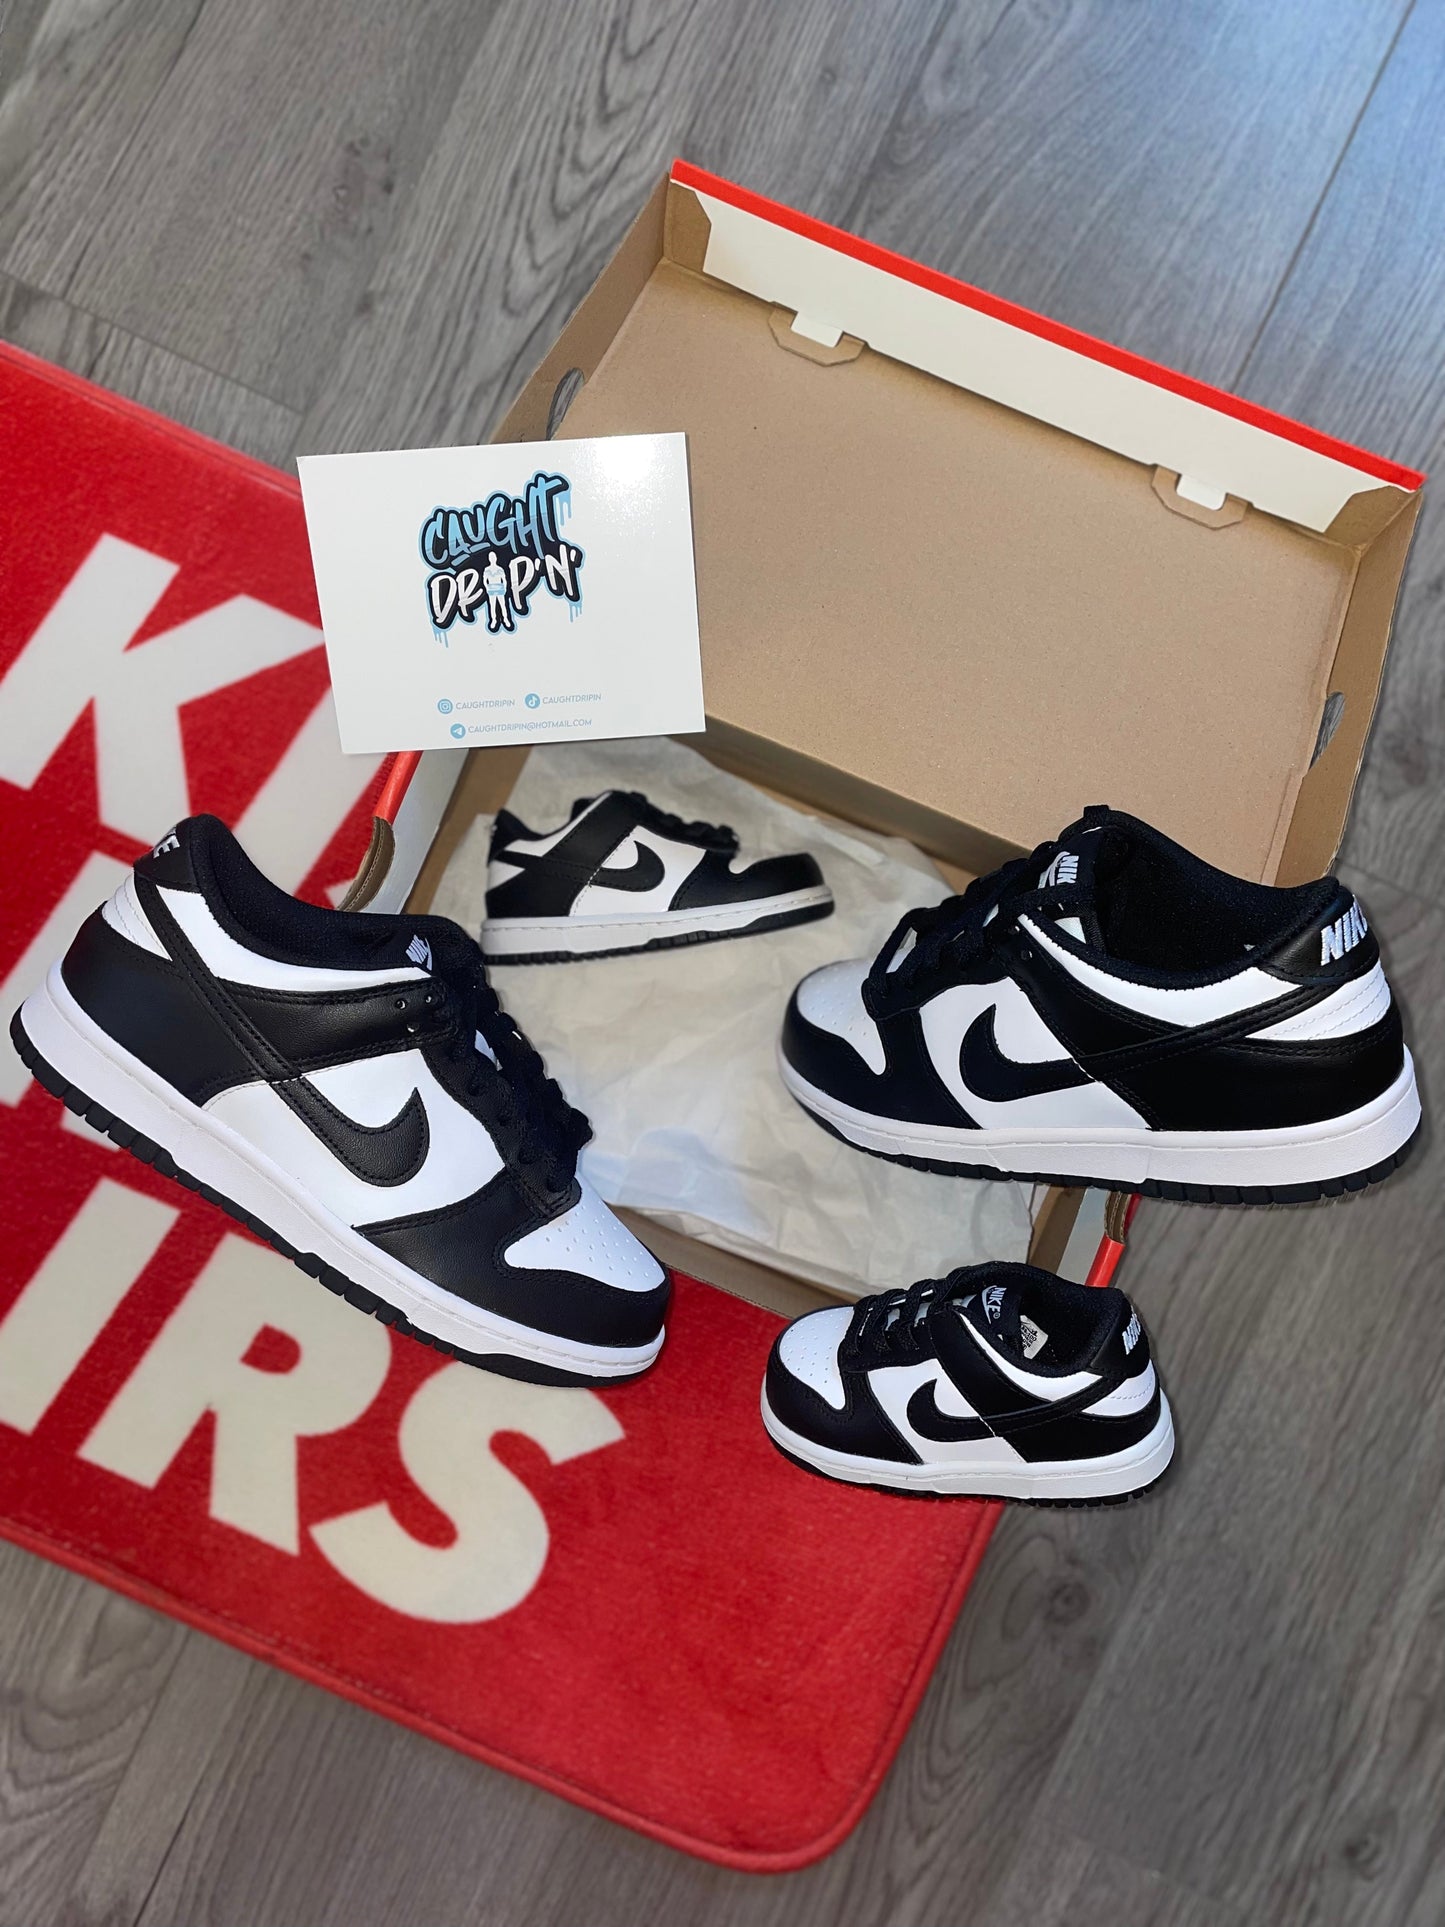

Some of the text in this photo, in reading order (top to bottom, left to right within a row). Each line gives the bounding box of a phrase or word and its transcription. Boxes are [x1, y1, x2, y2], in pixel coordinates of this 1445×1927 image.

[424, 476, 563, 566] CAUGHT
[455, 699, 516, 711] CAUGHTDRIPIN
[542, 693, 602, 705] CAUGHTDRIPIN
[467, 718, 593, 735] CAUGHTDRIPIN@HOTMAIL.COM
